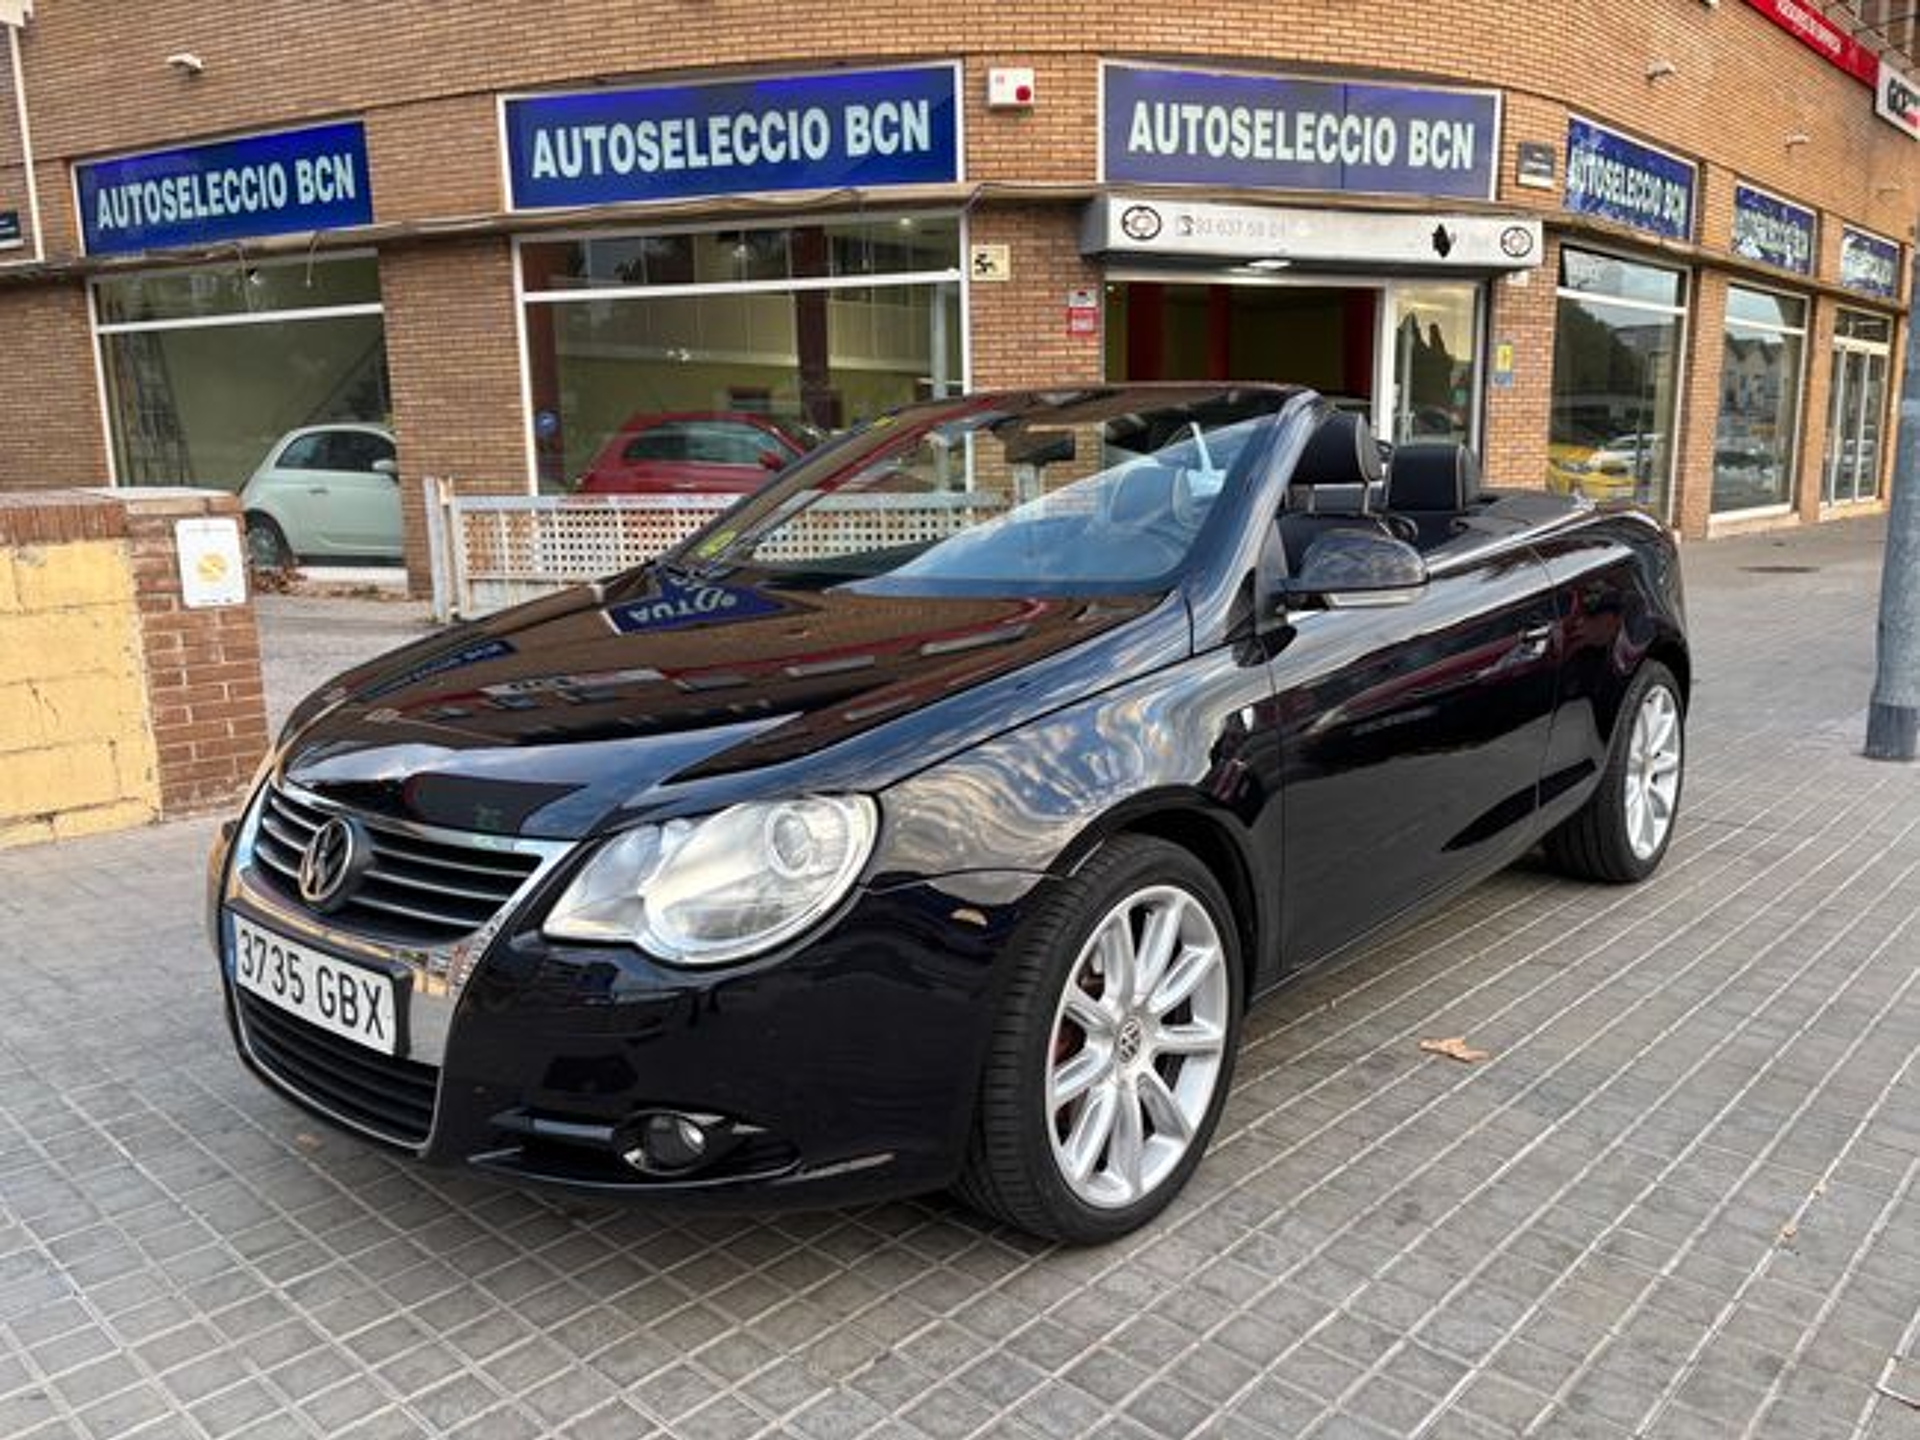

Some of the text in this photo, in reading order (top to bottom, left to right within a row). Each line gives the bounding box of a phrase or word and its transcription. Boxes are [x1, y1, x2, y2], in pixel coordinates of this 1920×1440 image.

[531, 99, 930, 179] AUTOSELECCIO BCN
[1127, 101, 1475, 170] AUTOSELECCIO BCN
[97, 153, 356, 230] AUTOSELECCIO BCN
[241, 929, 385, 1040] 3735 GBX
